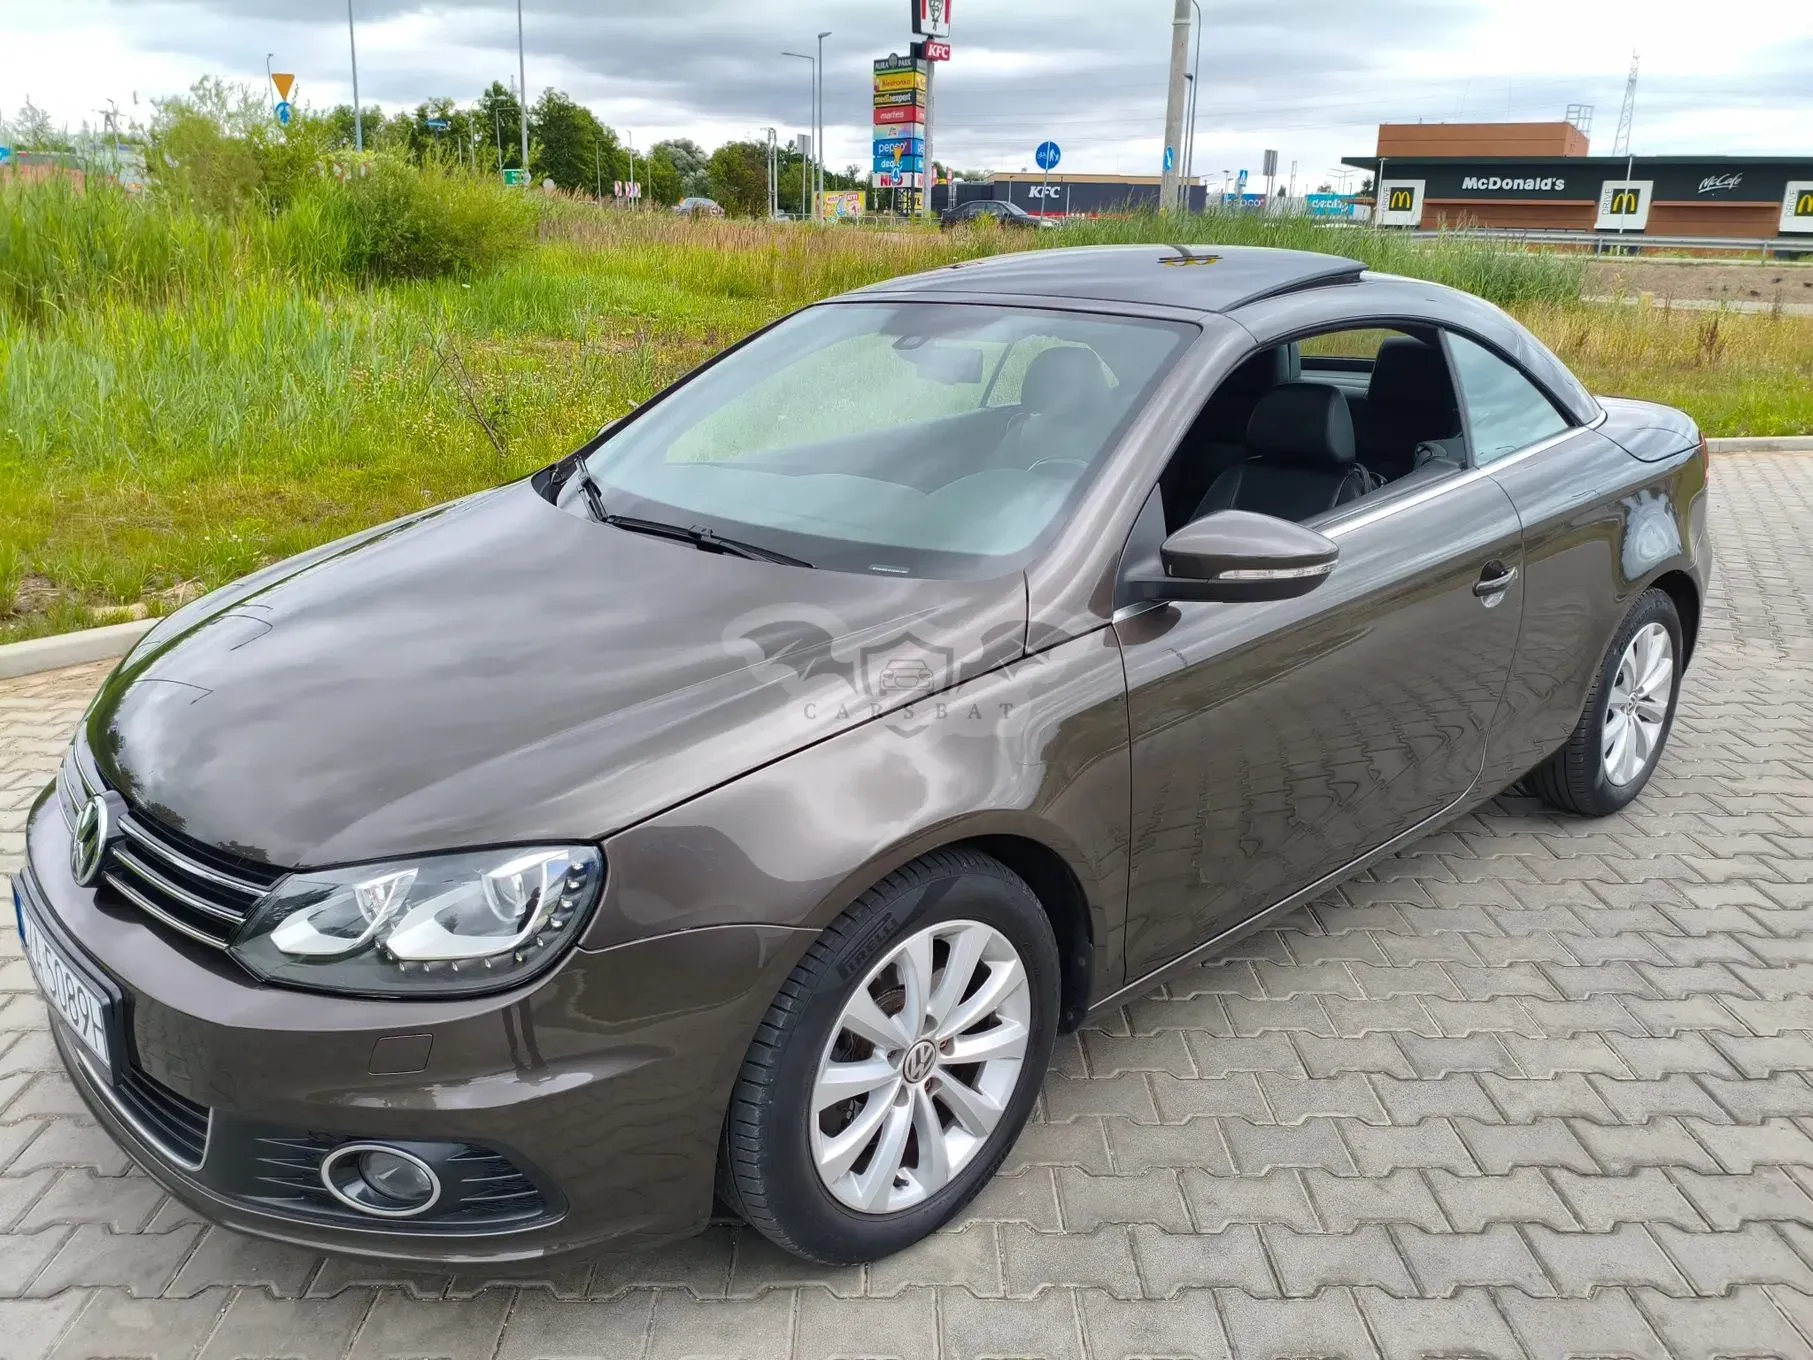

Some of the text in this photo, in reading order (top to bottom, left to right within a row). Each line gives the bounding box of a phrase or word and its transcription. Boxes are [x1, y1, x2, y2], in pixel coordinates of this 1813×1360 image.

[928, 44, 949, 58] KFC
[1462, 177, 1565, 190] McDonald's
[1028, 185, 1061, 198] KFC
[1382, 186, 1390, 213] DRIVE
[1601, 188, 1612, 215] DRIVE
